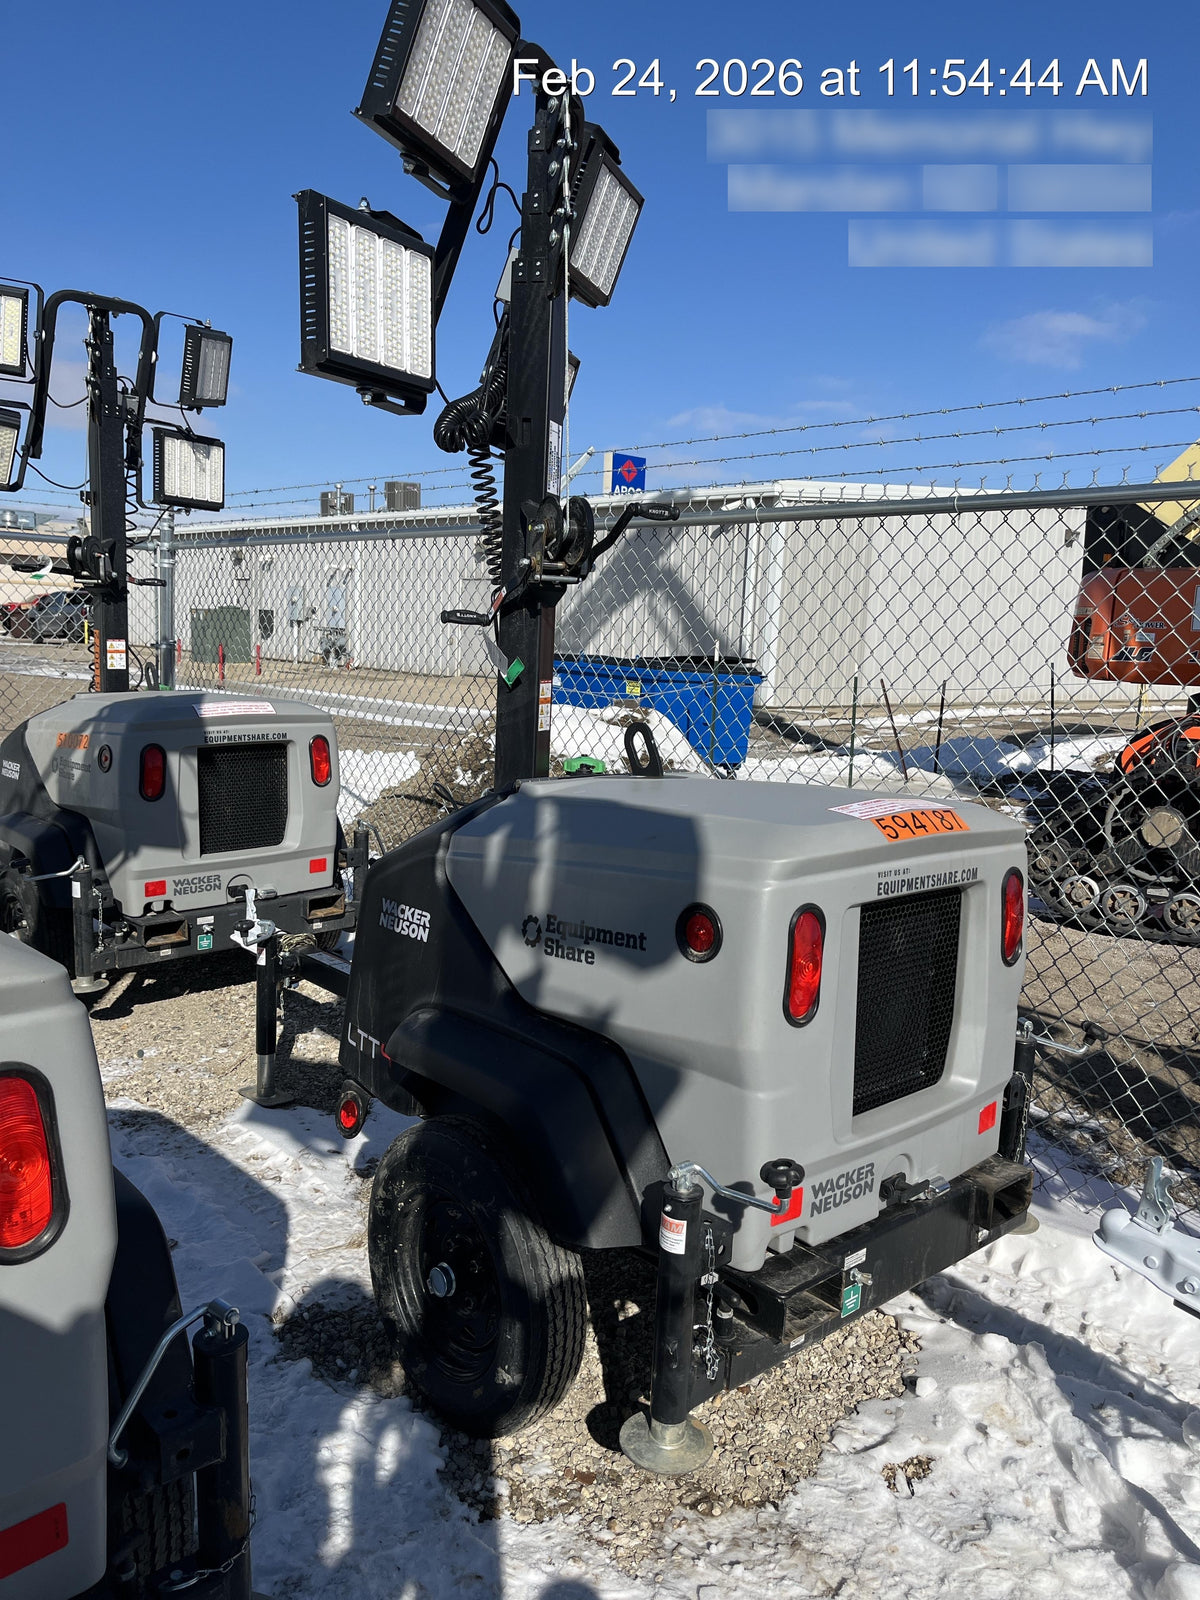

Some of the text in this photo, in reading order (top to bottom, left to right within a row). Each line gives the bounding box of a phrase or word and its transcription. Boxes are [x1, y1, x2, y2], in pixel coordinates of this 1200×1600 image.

[1111, 646, 1156, 662] JLG
[204, 732, 288, 744] EQUIPMENTSHARE.COM
[875, 809, 963, 840] 594187
[173, 874, 222, 887] WACKER
[877, 870, 892, 878] VISIT
[877, 867, 978, 896] EQUIPMENTSHARE.COM
[173, 882, 222, 896] NEUSON
[382, 897, 431, 928] WACKER
[379, 912, 430, 943] NEUSON
[545, 913, 647, 952] Equipment
[543, 936, 596, 965] Share
[811, 1162, 875, 1200] WACKER
[810, 1177, 875, 1218] NEUSON
